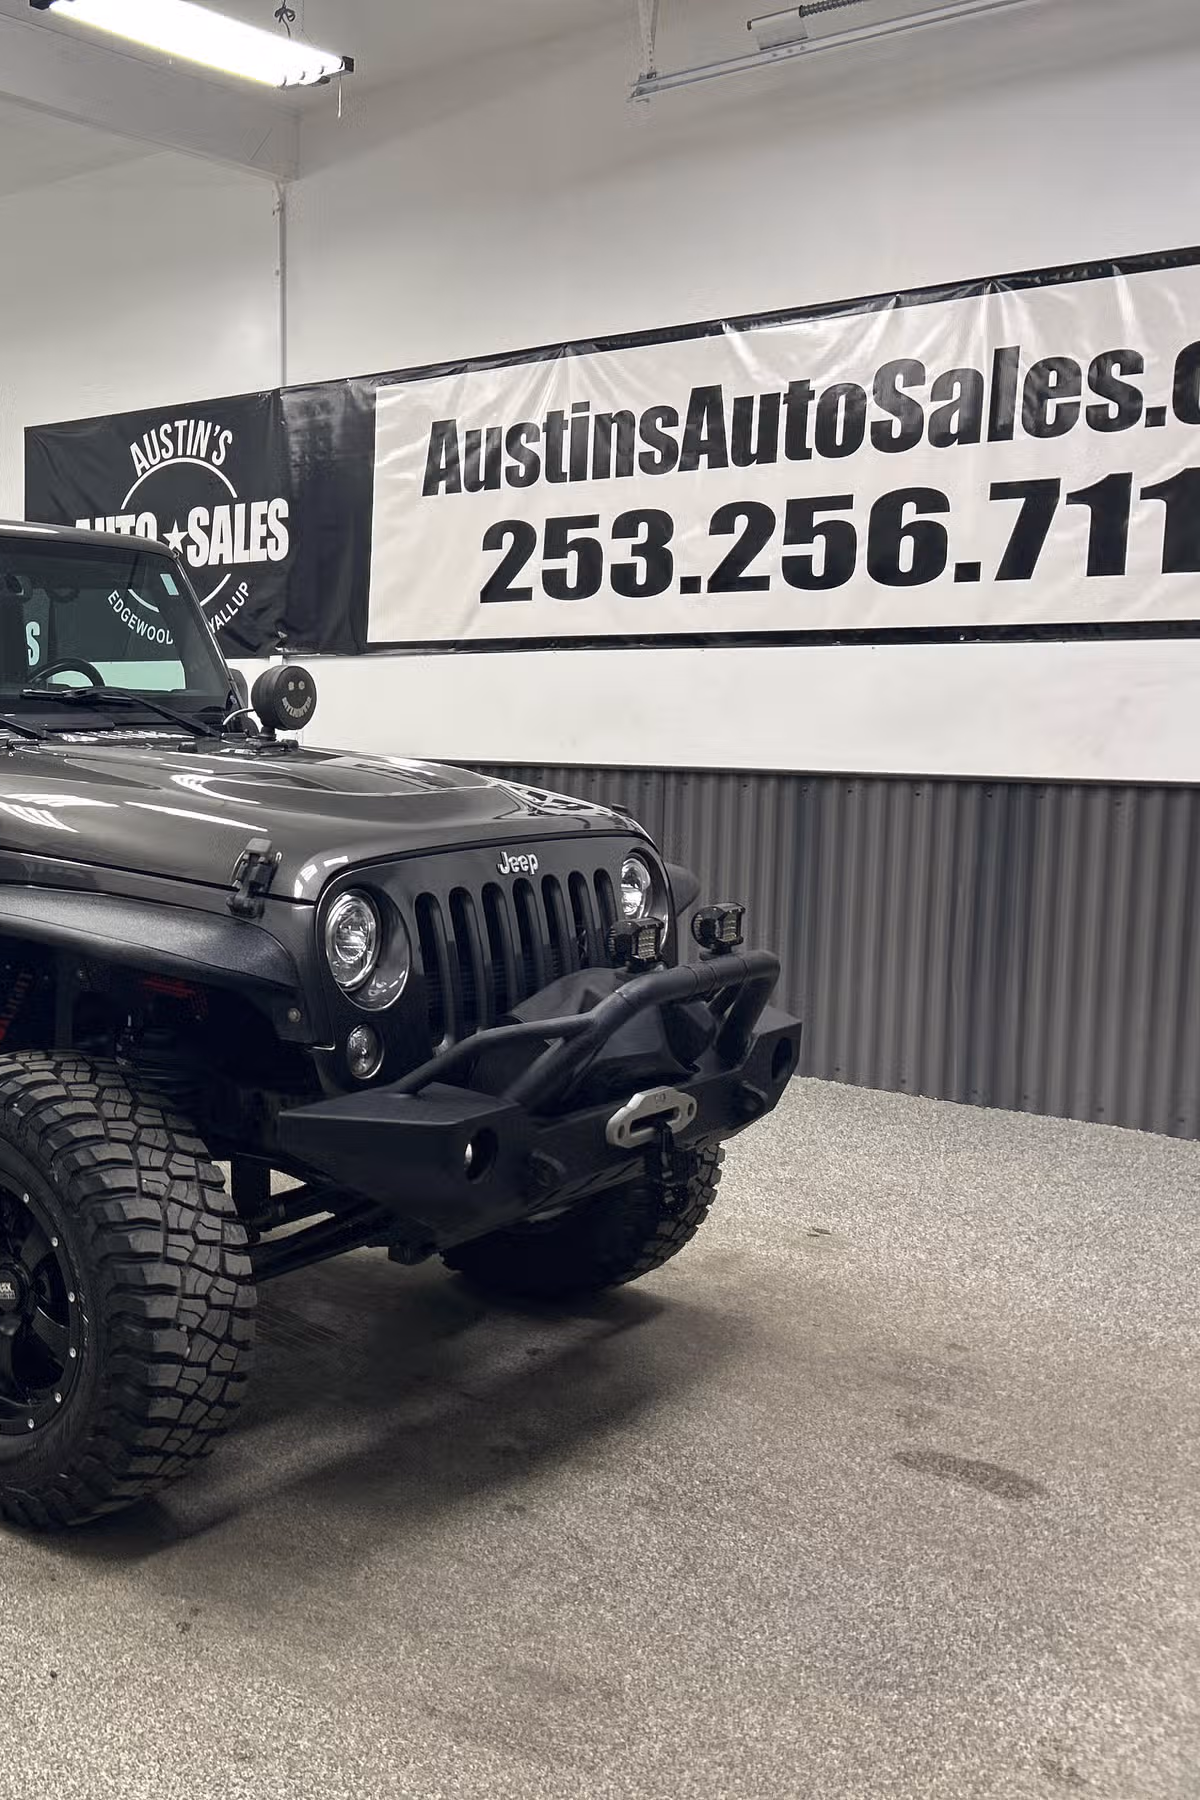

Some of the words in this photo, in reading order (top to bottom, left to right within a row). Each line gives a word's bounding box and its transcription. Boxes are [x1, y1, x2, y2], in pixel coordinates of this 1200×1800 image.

[129, 419, 233, 478] AUSTIN'S
[186, 498, 290, 568] SALES
[497, 851, 539, 875] Jeep
